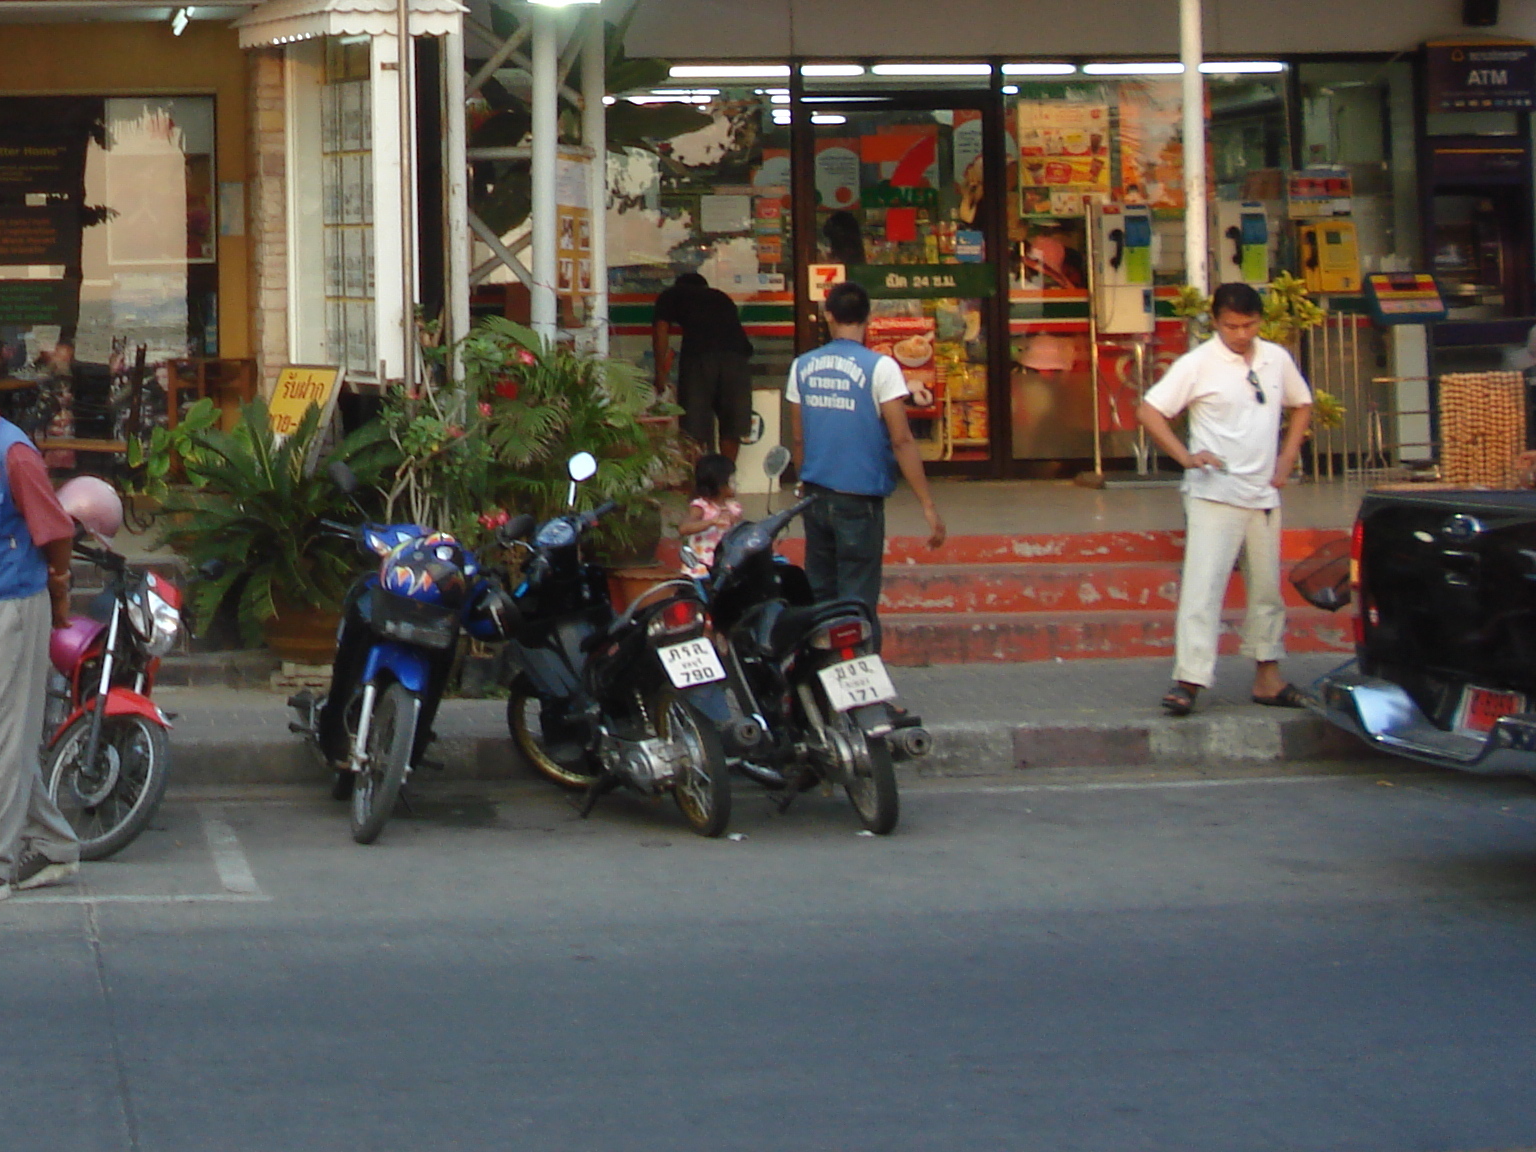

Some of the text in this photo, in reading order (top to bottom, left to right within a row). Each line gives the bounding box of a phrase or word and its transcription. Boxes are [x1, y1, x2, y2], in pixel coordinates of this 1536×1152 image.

[1467, 69, 1508, 85] ATM
[913, 275, 930, 287] 24
[283, 372, 325, 400] รับฝาก
[680, 666, 715, 683] 790
[848, 686, 879, 701] 171
